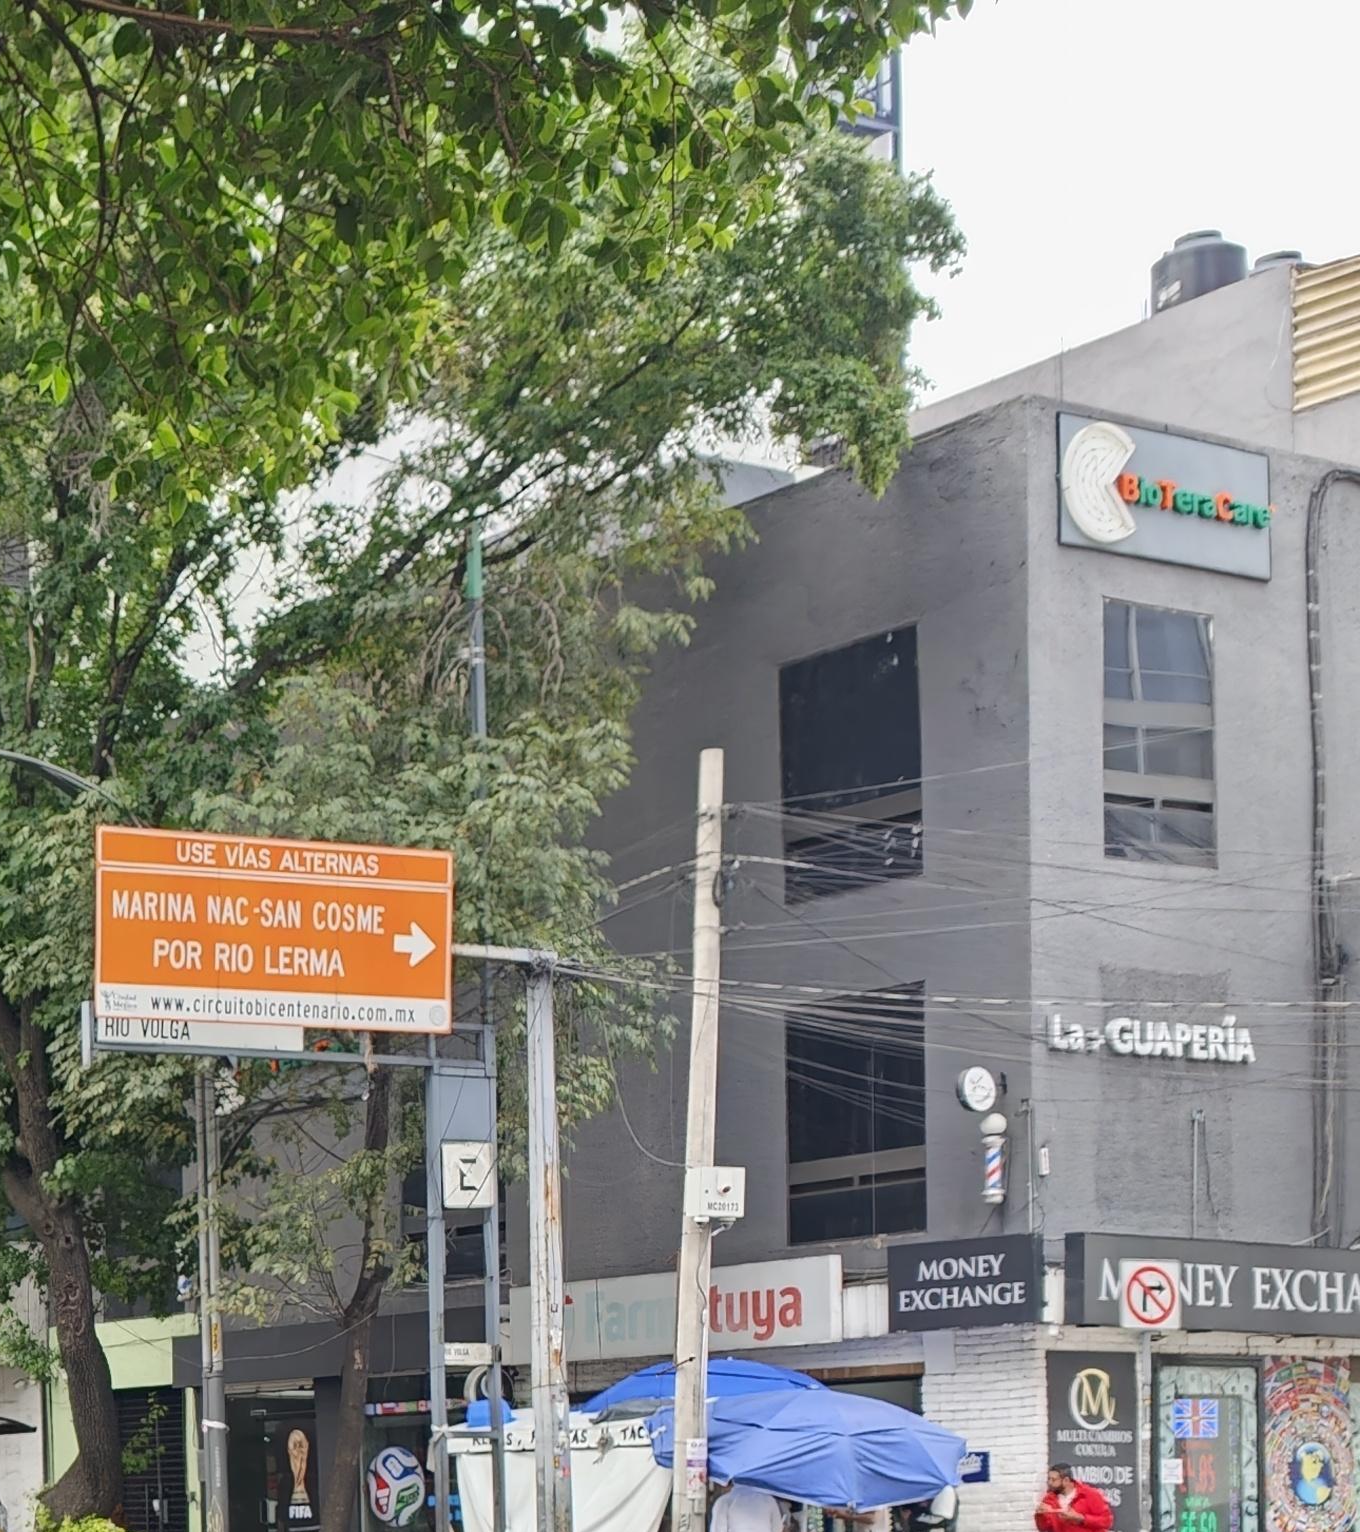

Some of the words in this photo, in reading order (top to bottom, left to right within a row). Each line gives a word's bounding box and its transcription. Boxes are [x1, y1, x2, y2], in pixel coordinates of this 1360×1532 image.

[176, 841, 216, 865] USE
[225, 842, 271, 869] VÍAS
[280, 851, 379, 876] ALTERNAS
[112, 889, 197, 922] MARINA
[312, 901, 385, 935] COSME
[153, 939, 202, 970] POR
[214, 944, 254, 973] RIO
[265, 946, 345, 977] LERMA
[151, 993, 416, 1024] www.circuitobicentenario.com.mx
[105, 1016, 130, 1037] RIO
[141, 1018, 191, 1041] VOLGA
[1104, 1015, 1257, 1064] GUAPERÍA
[917, 1252, 1007, 1283] MONEY
[1097, 1256, 1239, 1310] MNEY
[898, 1280, 1026, 1313] EXCHANGE
[1114, 1466, 1134, 1485] DE
[288, 1504, 313, 1519] FIFA
